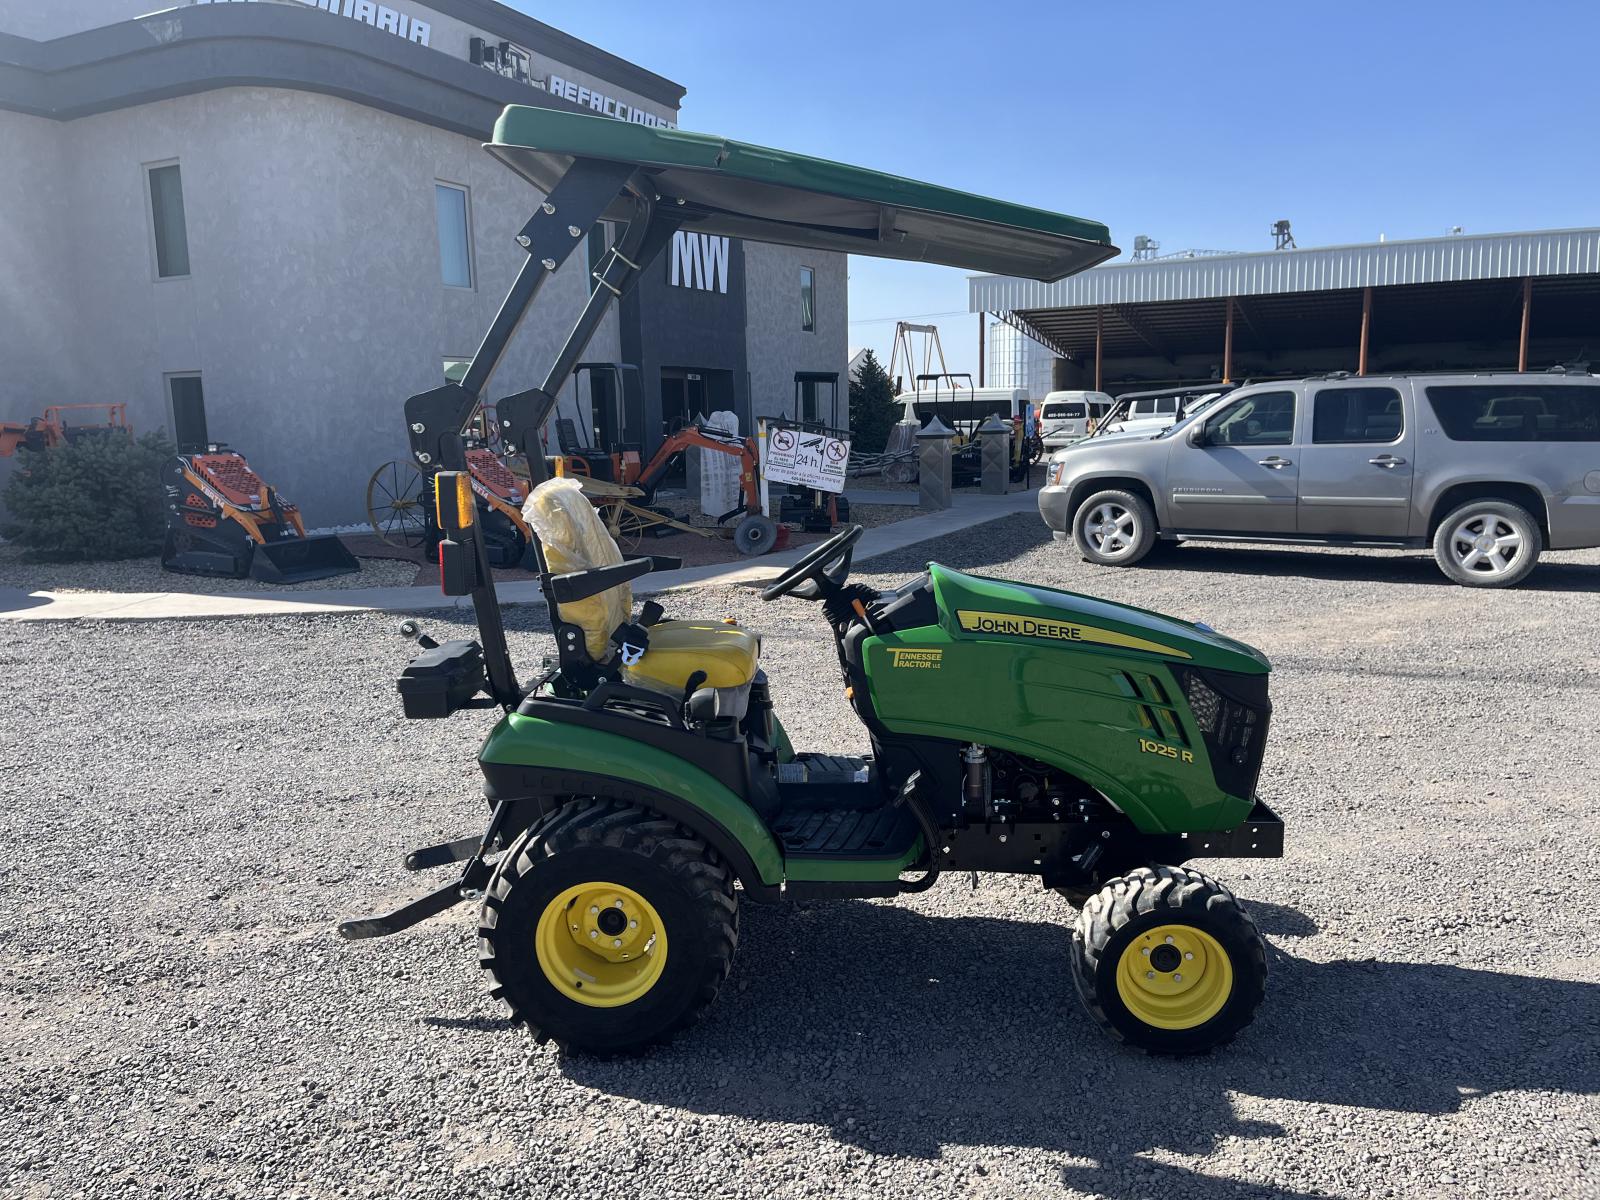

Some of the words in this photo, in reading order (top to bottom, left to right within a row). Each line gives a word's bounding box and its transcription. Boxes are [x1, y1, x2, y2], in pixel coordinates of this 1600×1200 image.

[671, 230, 730, 294] MW
[796, 454, 808, 466] 24
[811, 456, 819, 468] h.
[972, 616, 1019, 633] JOHN
[1023, 620, 1081, 639] DEERE
[886, 648, 943, 662] TENNESSEE
[1139, 738, 1178, 759] 1025
[1181, 750, 1193, 763] R
